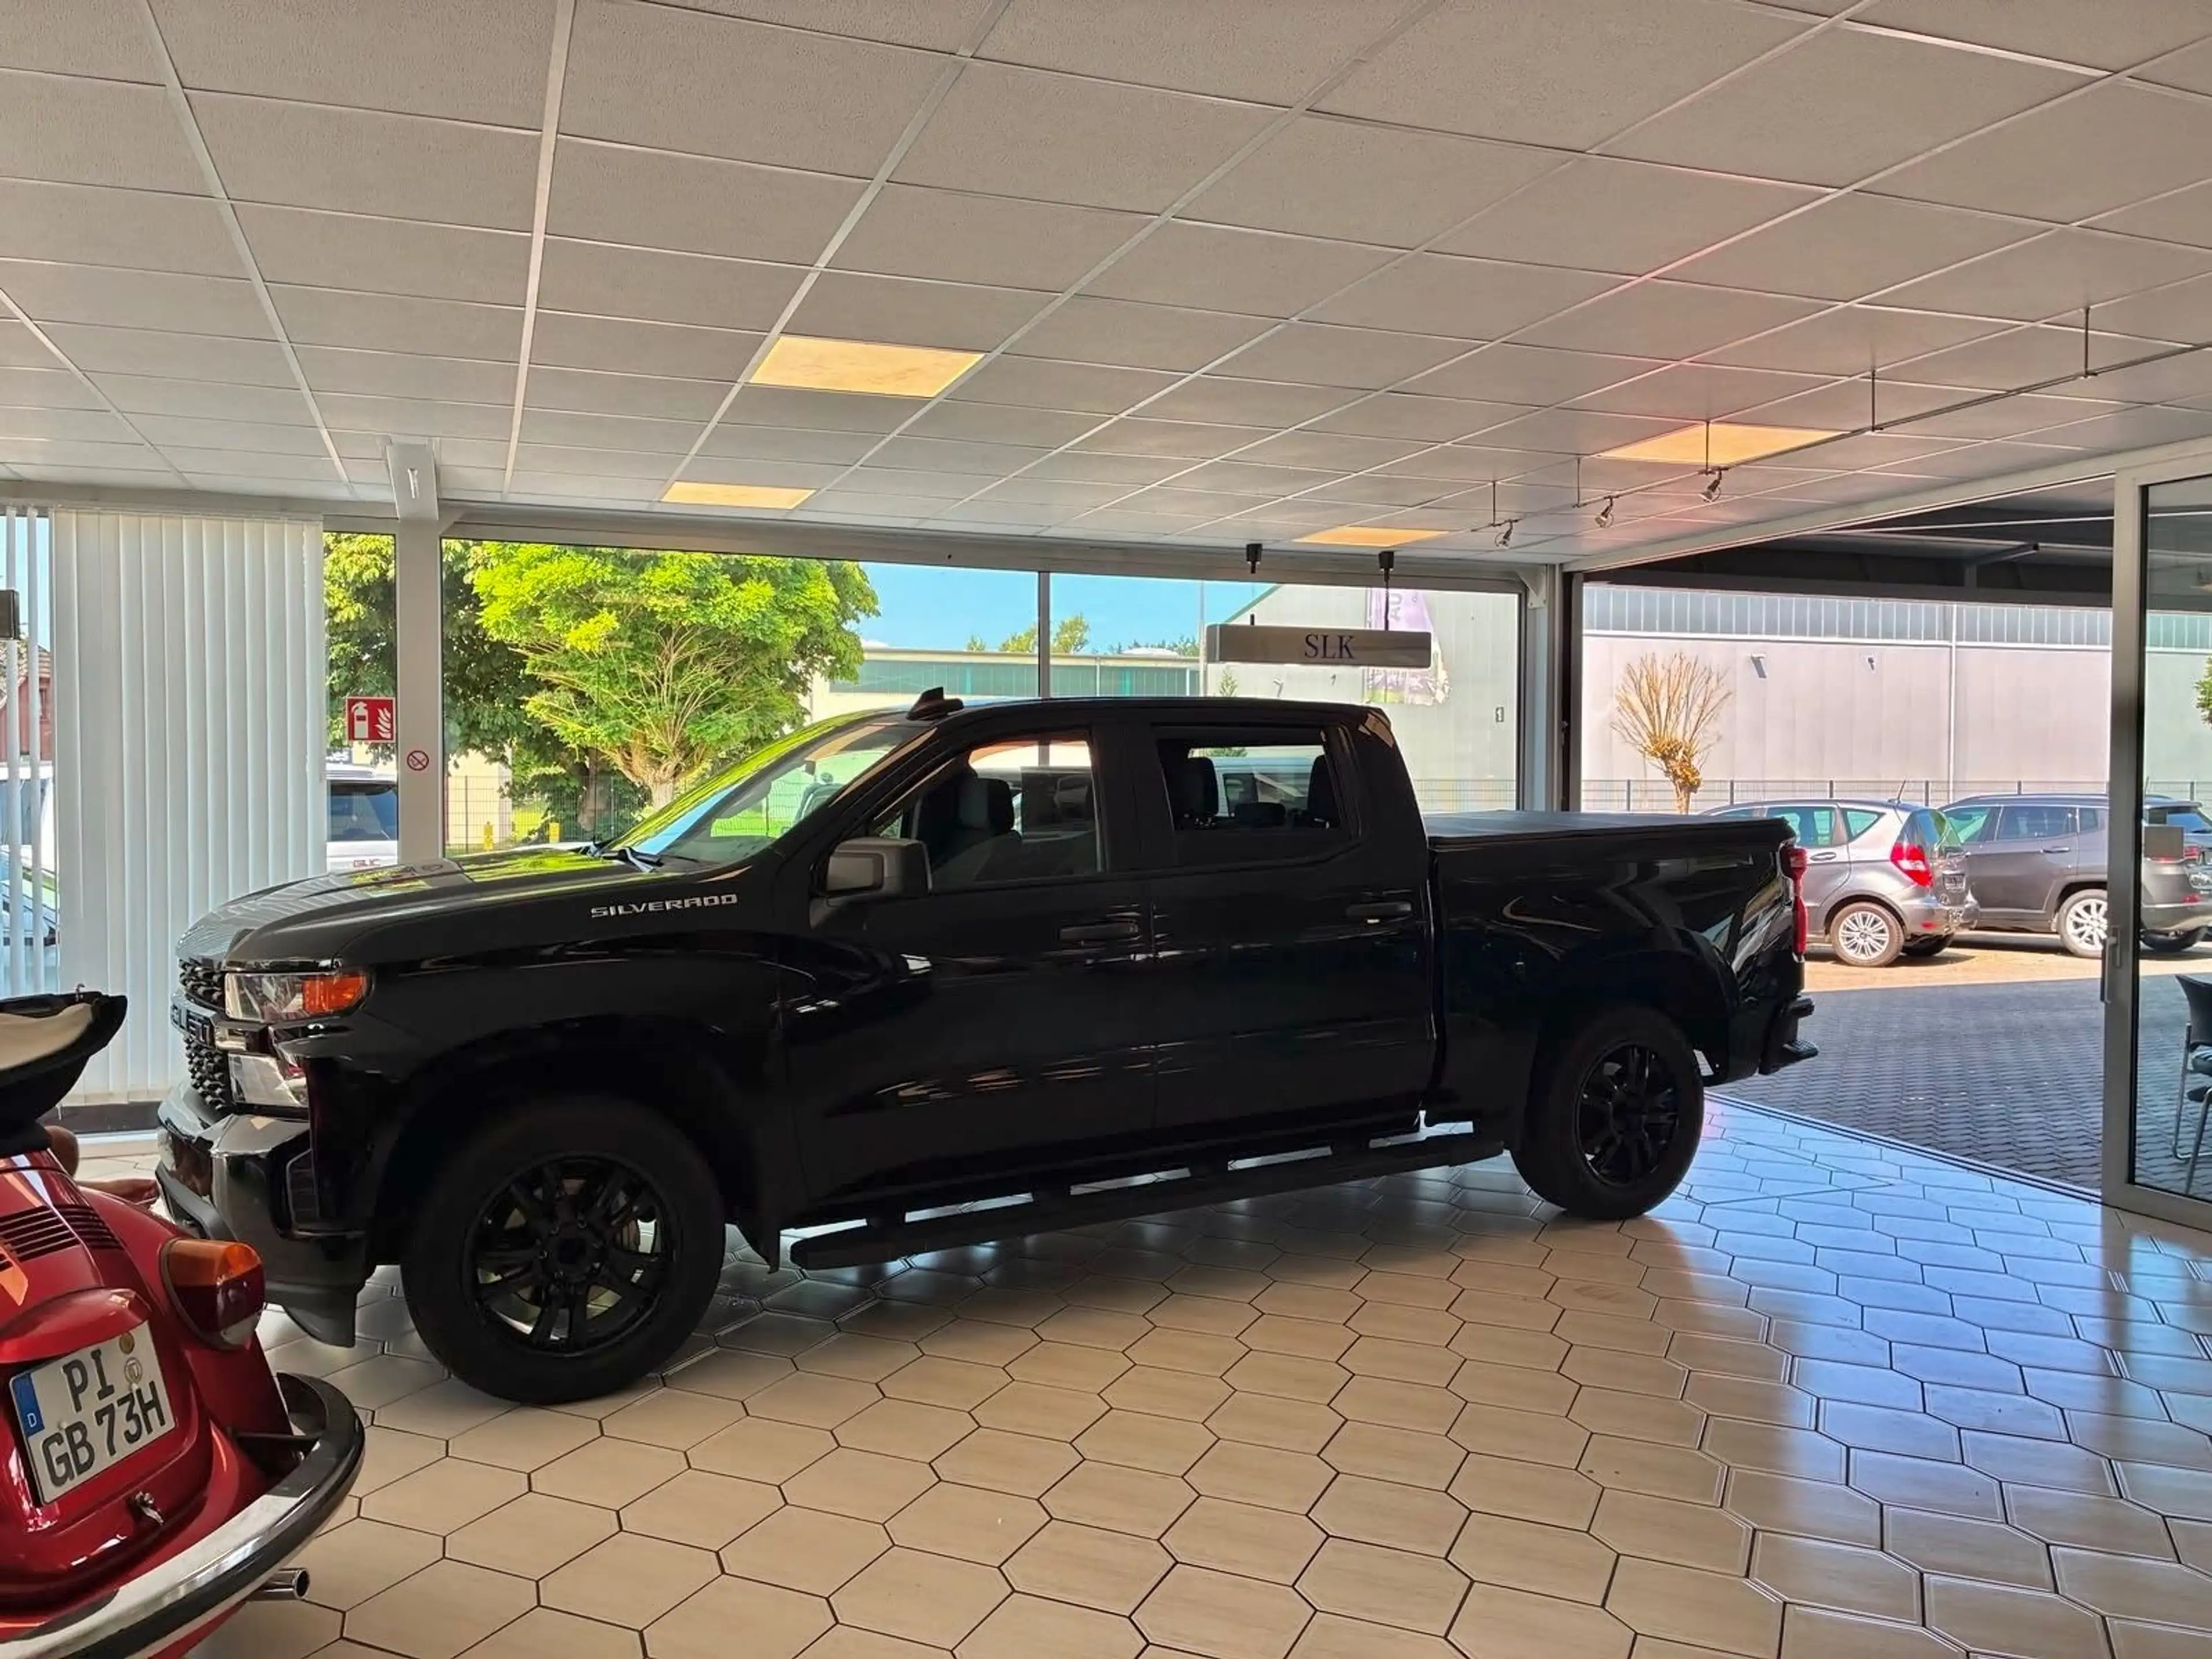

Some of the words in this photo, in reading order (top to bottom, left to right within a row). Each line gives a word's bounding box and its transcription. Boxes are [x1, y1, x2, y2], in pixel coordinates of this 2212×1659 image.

[1304, 634, 1354, 659] SLK
[590, 893, 738, 918] SILVERADO
[62, 1349, 115, 1413] PI
[27, 1412, 37, 1428] D
[42, 1421, 95, 1487] GB
[94, 1380, 166, 1456] 73H
